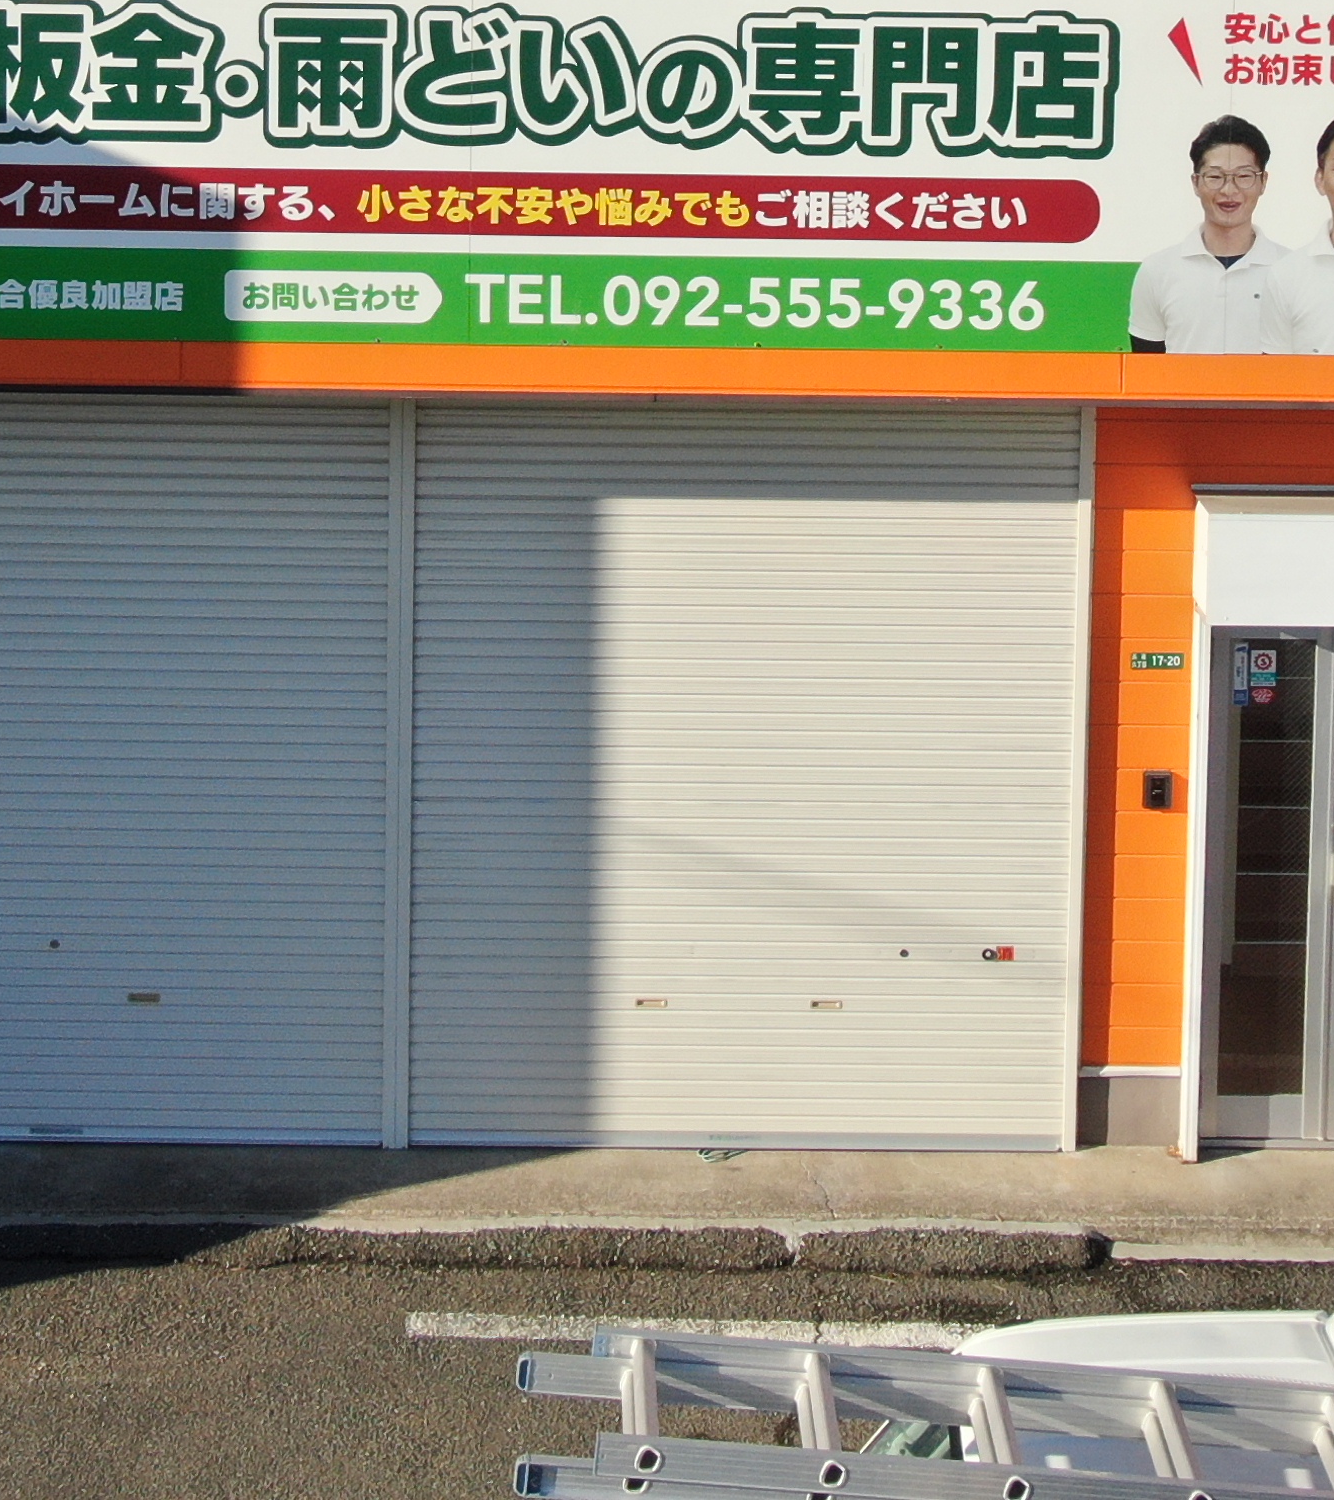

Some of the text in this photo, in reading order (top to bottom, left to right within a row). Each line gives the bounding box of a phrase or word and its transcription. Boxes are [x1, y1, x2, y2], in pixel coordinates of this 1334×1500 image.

[241, 281, 420, 313] お問い合わせ
[464, 273, 1046, 332] TEL.092-555-9336
[1152, 655, 1181, 667] 17-20
